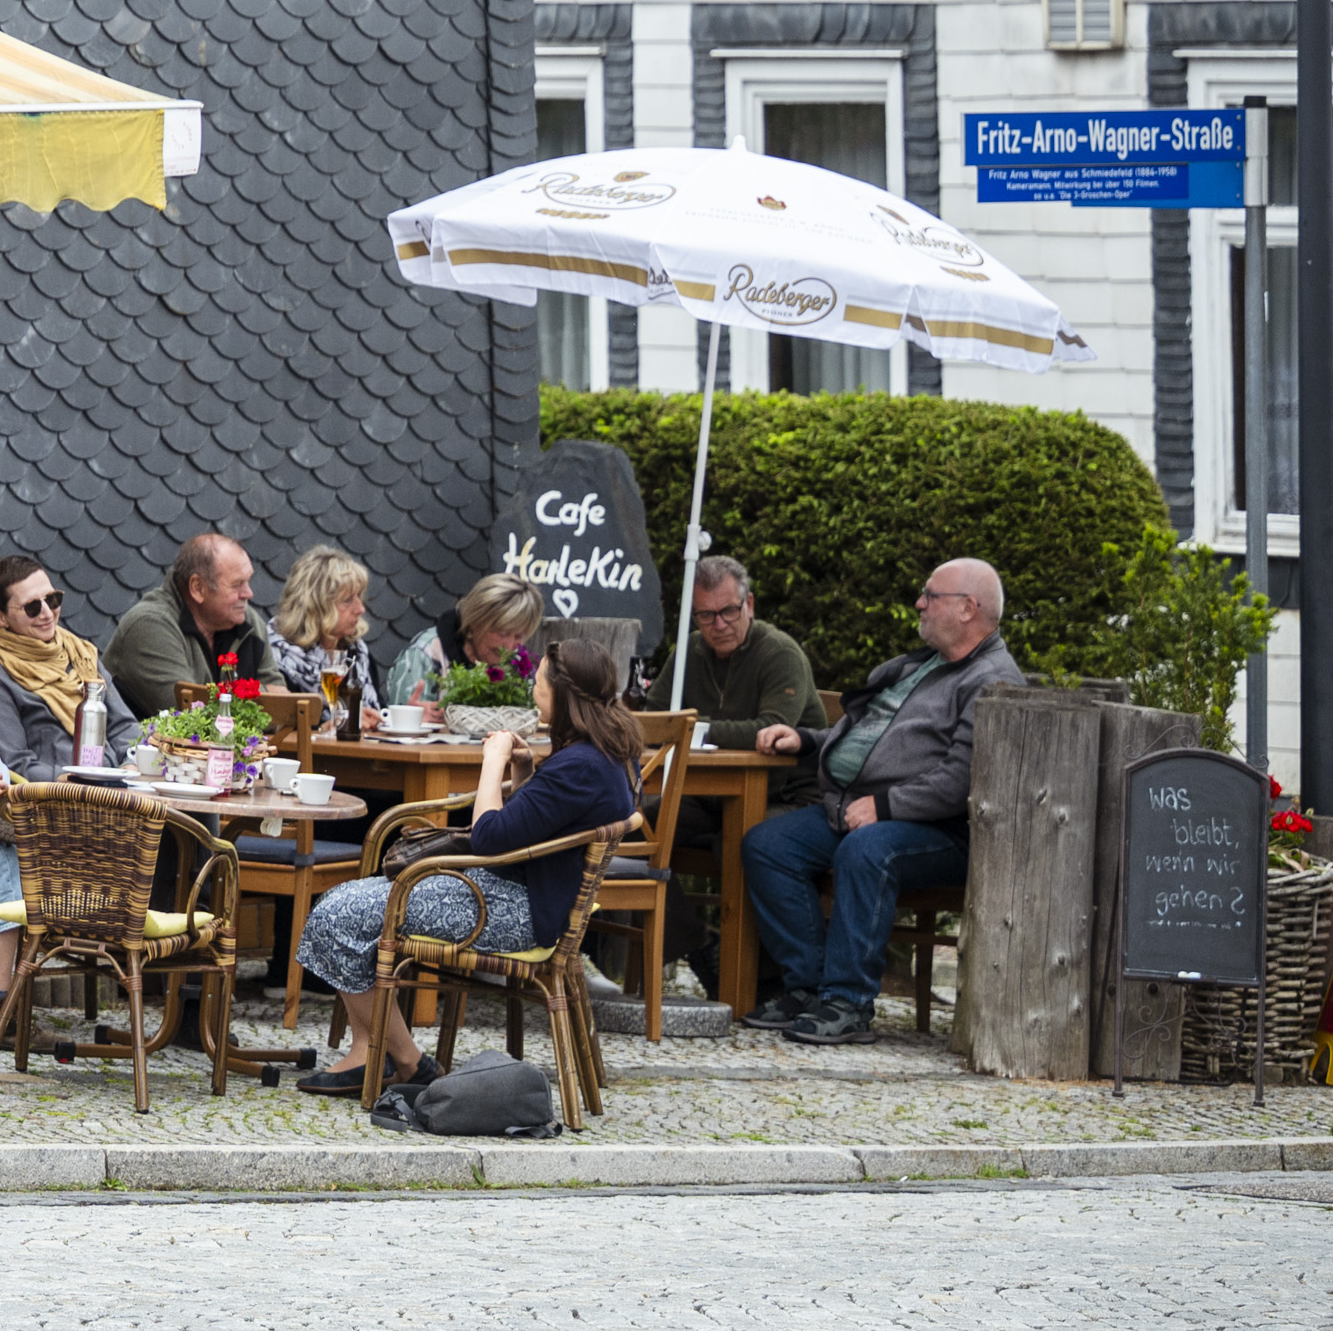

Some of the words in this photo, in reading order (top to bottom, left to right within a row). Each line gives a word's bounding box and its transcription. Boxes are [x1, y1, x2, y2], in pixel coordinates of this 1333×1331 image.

[977, 117, 1233, 160] Fritz-Arno-Wagner-Straße
[989, 169, 1007, 180] Fritz
[1010, 169, 1029, 179] Arno
[1032, 169, 1061, 181] Wagner
[1064, 170, 1078, 178] aus
[1081, 167, 1133, 178] Schmiedefeld
[1054, 180, 1091, 190] Mitwirkung
[1093, 181, 1103, 189] bei
[1105, 180, 1120, 188] über
[723, 263, 836, 322] Radeberger
[535, 490, 606, 537] Cafe
[1207, 854, 1240, 876] wir
[1155, 884, 1223, 916] gehen
